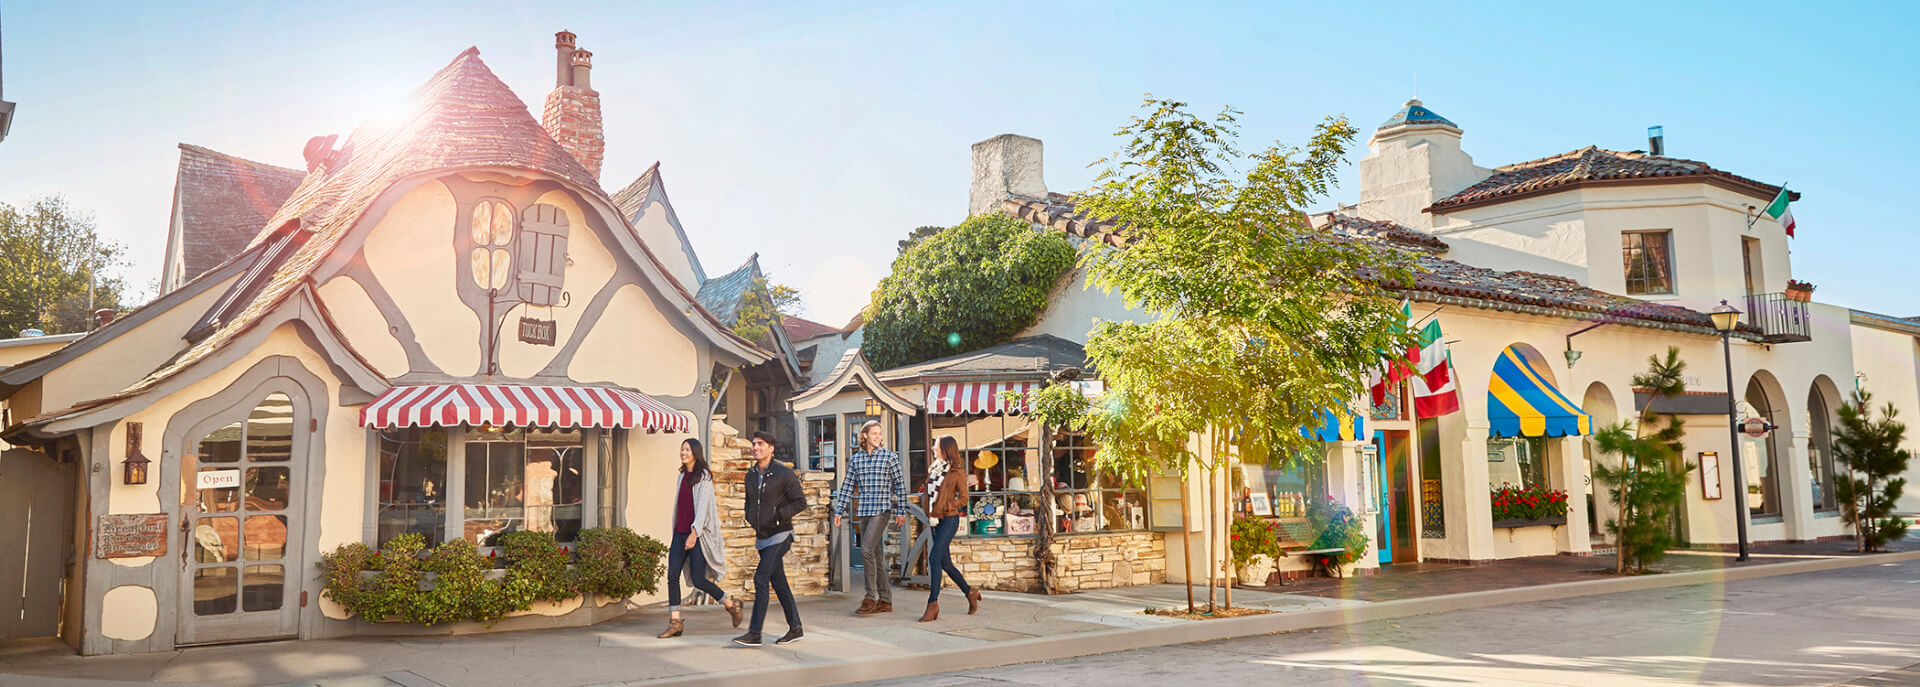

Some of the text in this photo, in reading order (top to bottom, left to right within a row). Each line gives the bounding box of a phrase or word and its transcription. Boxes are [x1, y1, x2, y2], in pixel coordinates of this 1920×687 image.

[522, 322, 550, 340] TUCK BOX
[203, 475, 233, 485] Open
